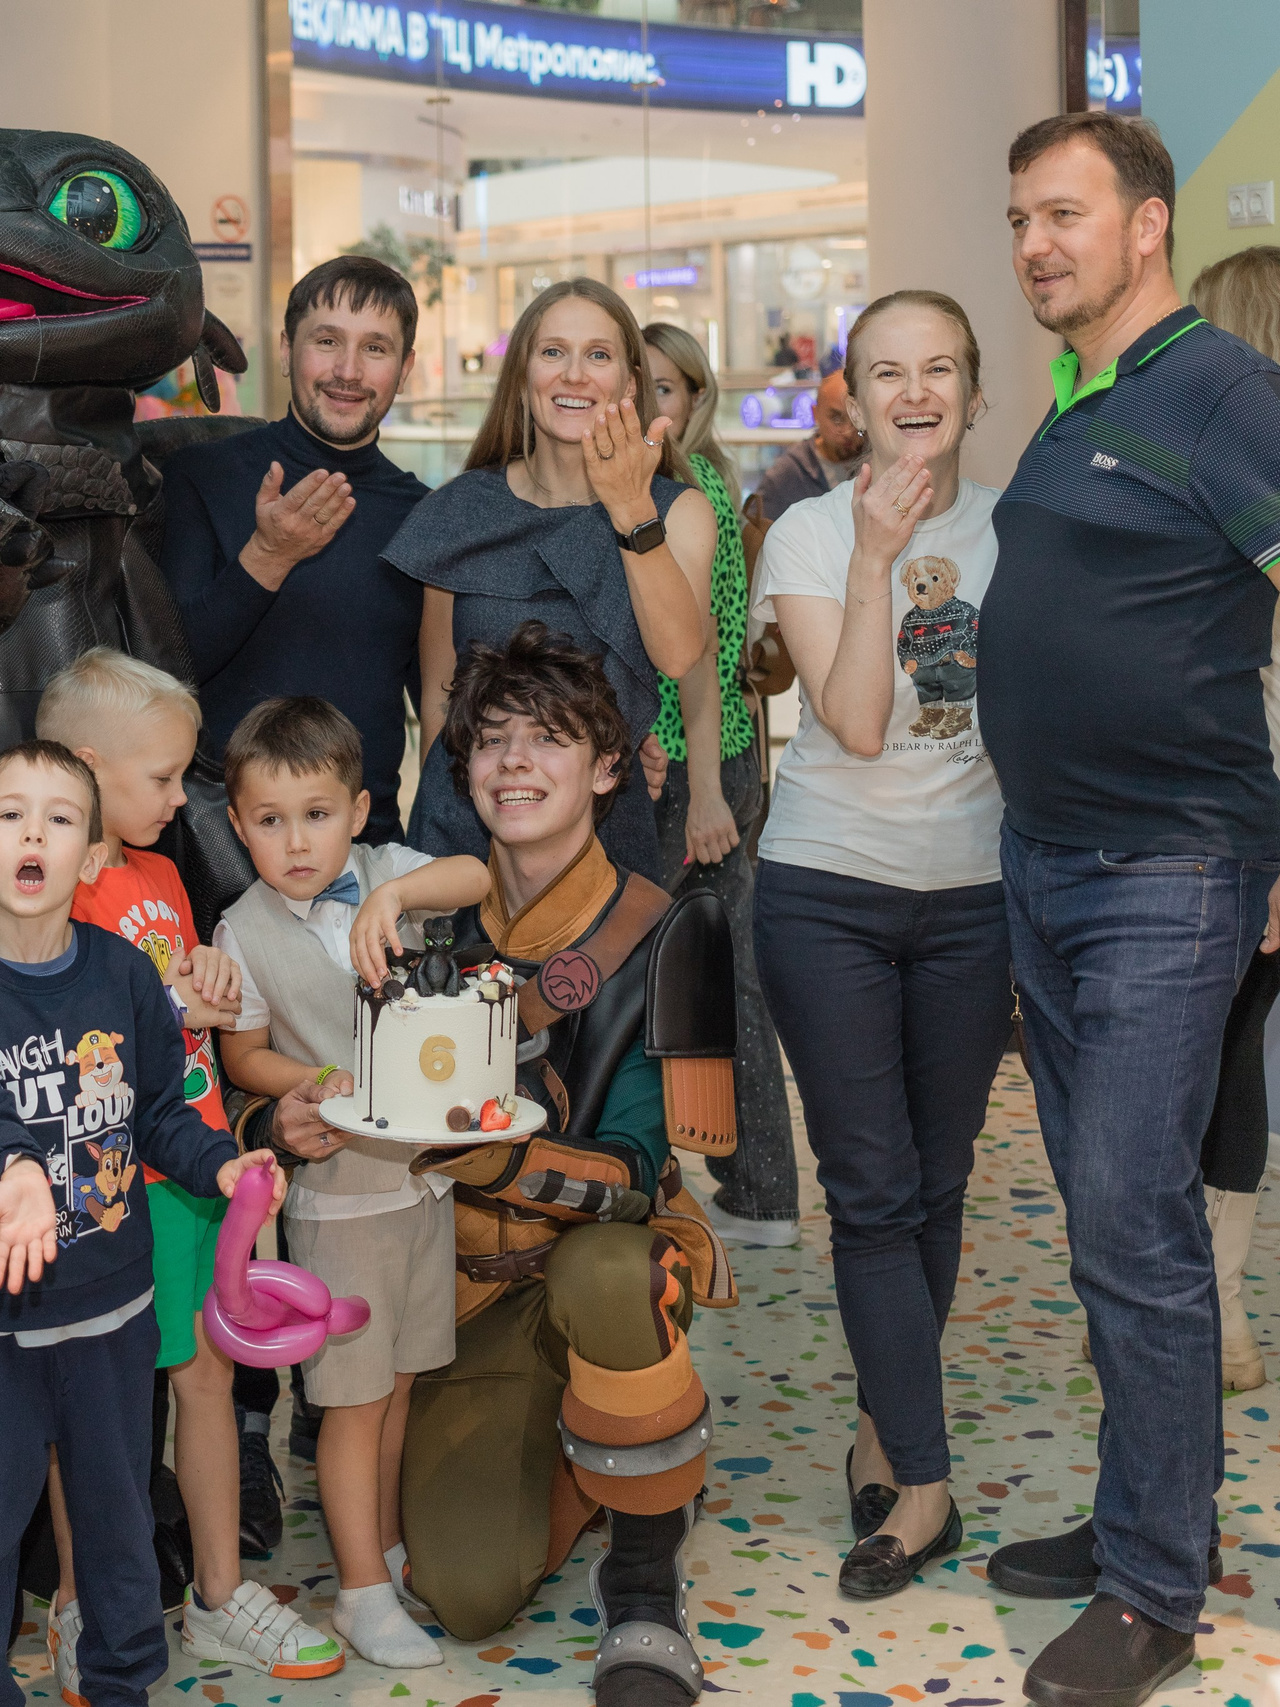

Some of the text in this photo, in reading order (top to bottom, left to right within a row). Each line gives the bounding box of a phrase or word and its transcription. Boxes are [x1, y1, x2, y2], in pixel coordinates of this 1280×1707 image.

[288, 0, 406, 57] ЕКЛАМА
[407, 11, 429, 60] В
[474, 22, 658, 86] Метрополис
[786, 41, 867, 108] HD
[1092, 452, 1119, 467] BOSS
[893, 742, 920, 751] BEAR
[924, 742, 935, 752] by
[938, 739, 971, 750] RALPH
[116, 900, 180, 941] RY DAY
[419, 1034, 457, 1082] 6
[1, 1071, 65, 1119] UT
[67, 1087, 135, 1137] LOUD
